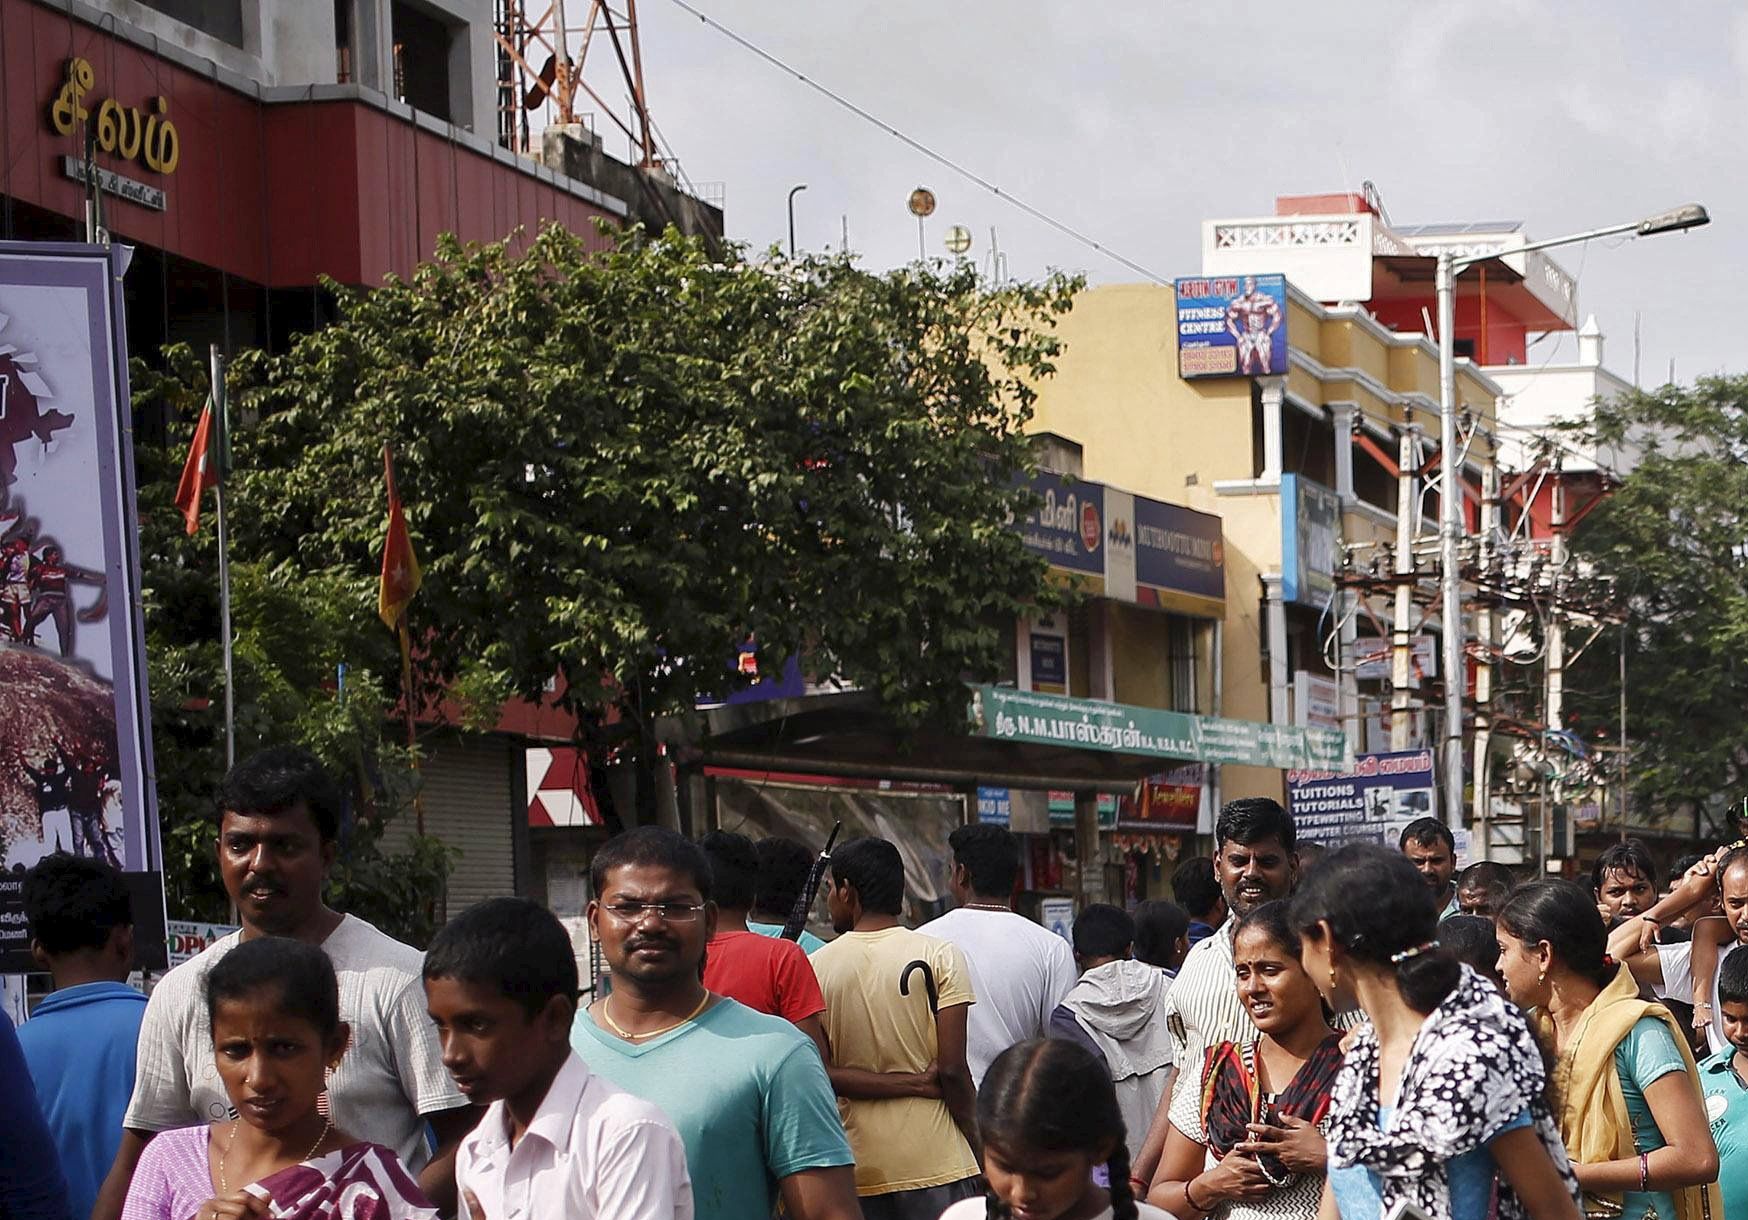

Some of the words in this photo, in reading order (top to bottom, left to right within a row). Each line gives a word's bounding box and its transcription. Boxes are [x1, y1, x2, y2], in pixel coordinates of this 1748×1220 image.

[1179, 307, 1225, 321] FITNESS
[1180, 321, 1226, 335] CENTRE
[1292, 784, 1355, 800] TUITIONS
[1293, 798, 1364, 813] TUTORIALS
[1294, 811, 1364, 826] TYPEWRITING
[1296, 826, 1341, 841] COMPUTER
[1343, 823, 1384, 835] COURSES
